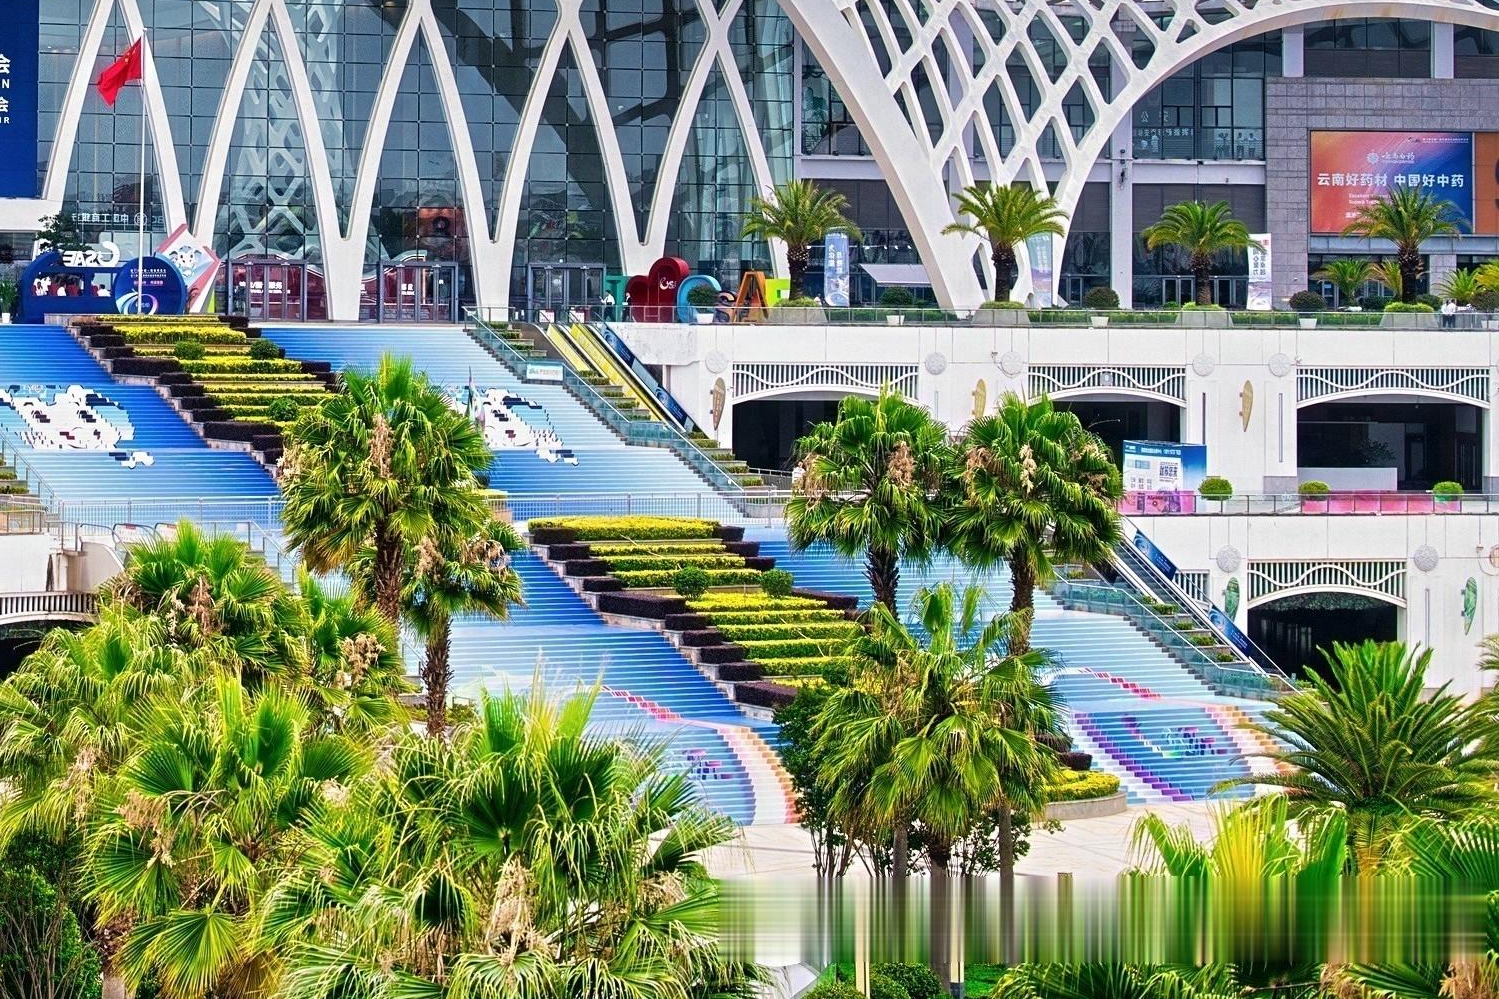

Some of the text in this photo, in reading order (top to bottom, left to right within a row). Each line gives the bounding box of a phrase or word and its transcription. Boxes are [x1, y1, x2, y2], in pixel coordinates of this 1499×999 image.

[1317, 173, 1464, 188] 云南好药材 中国好中药
